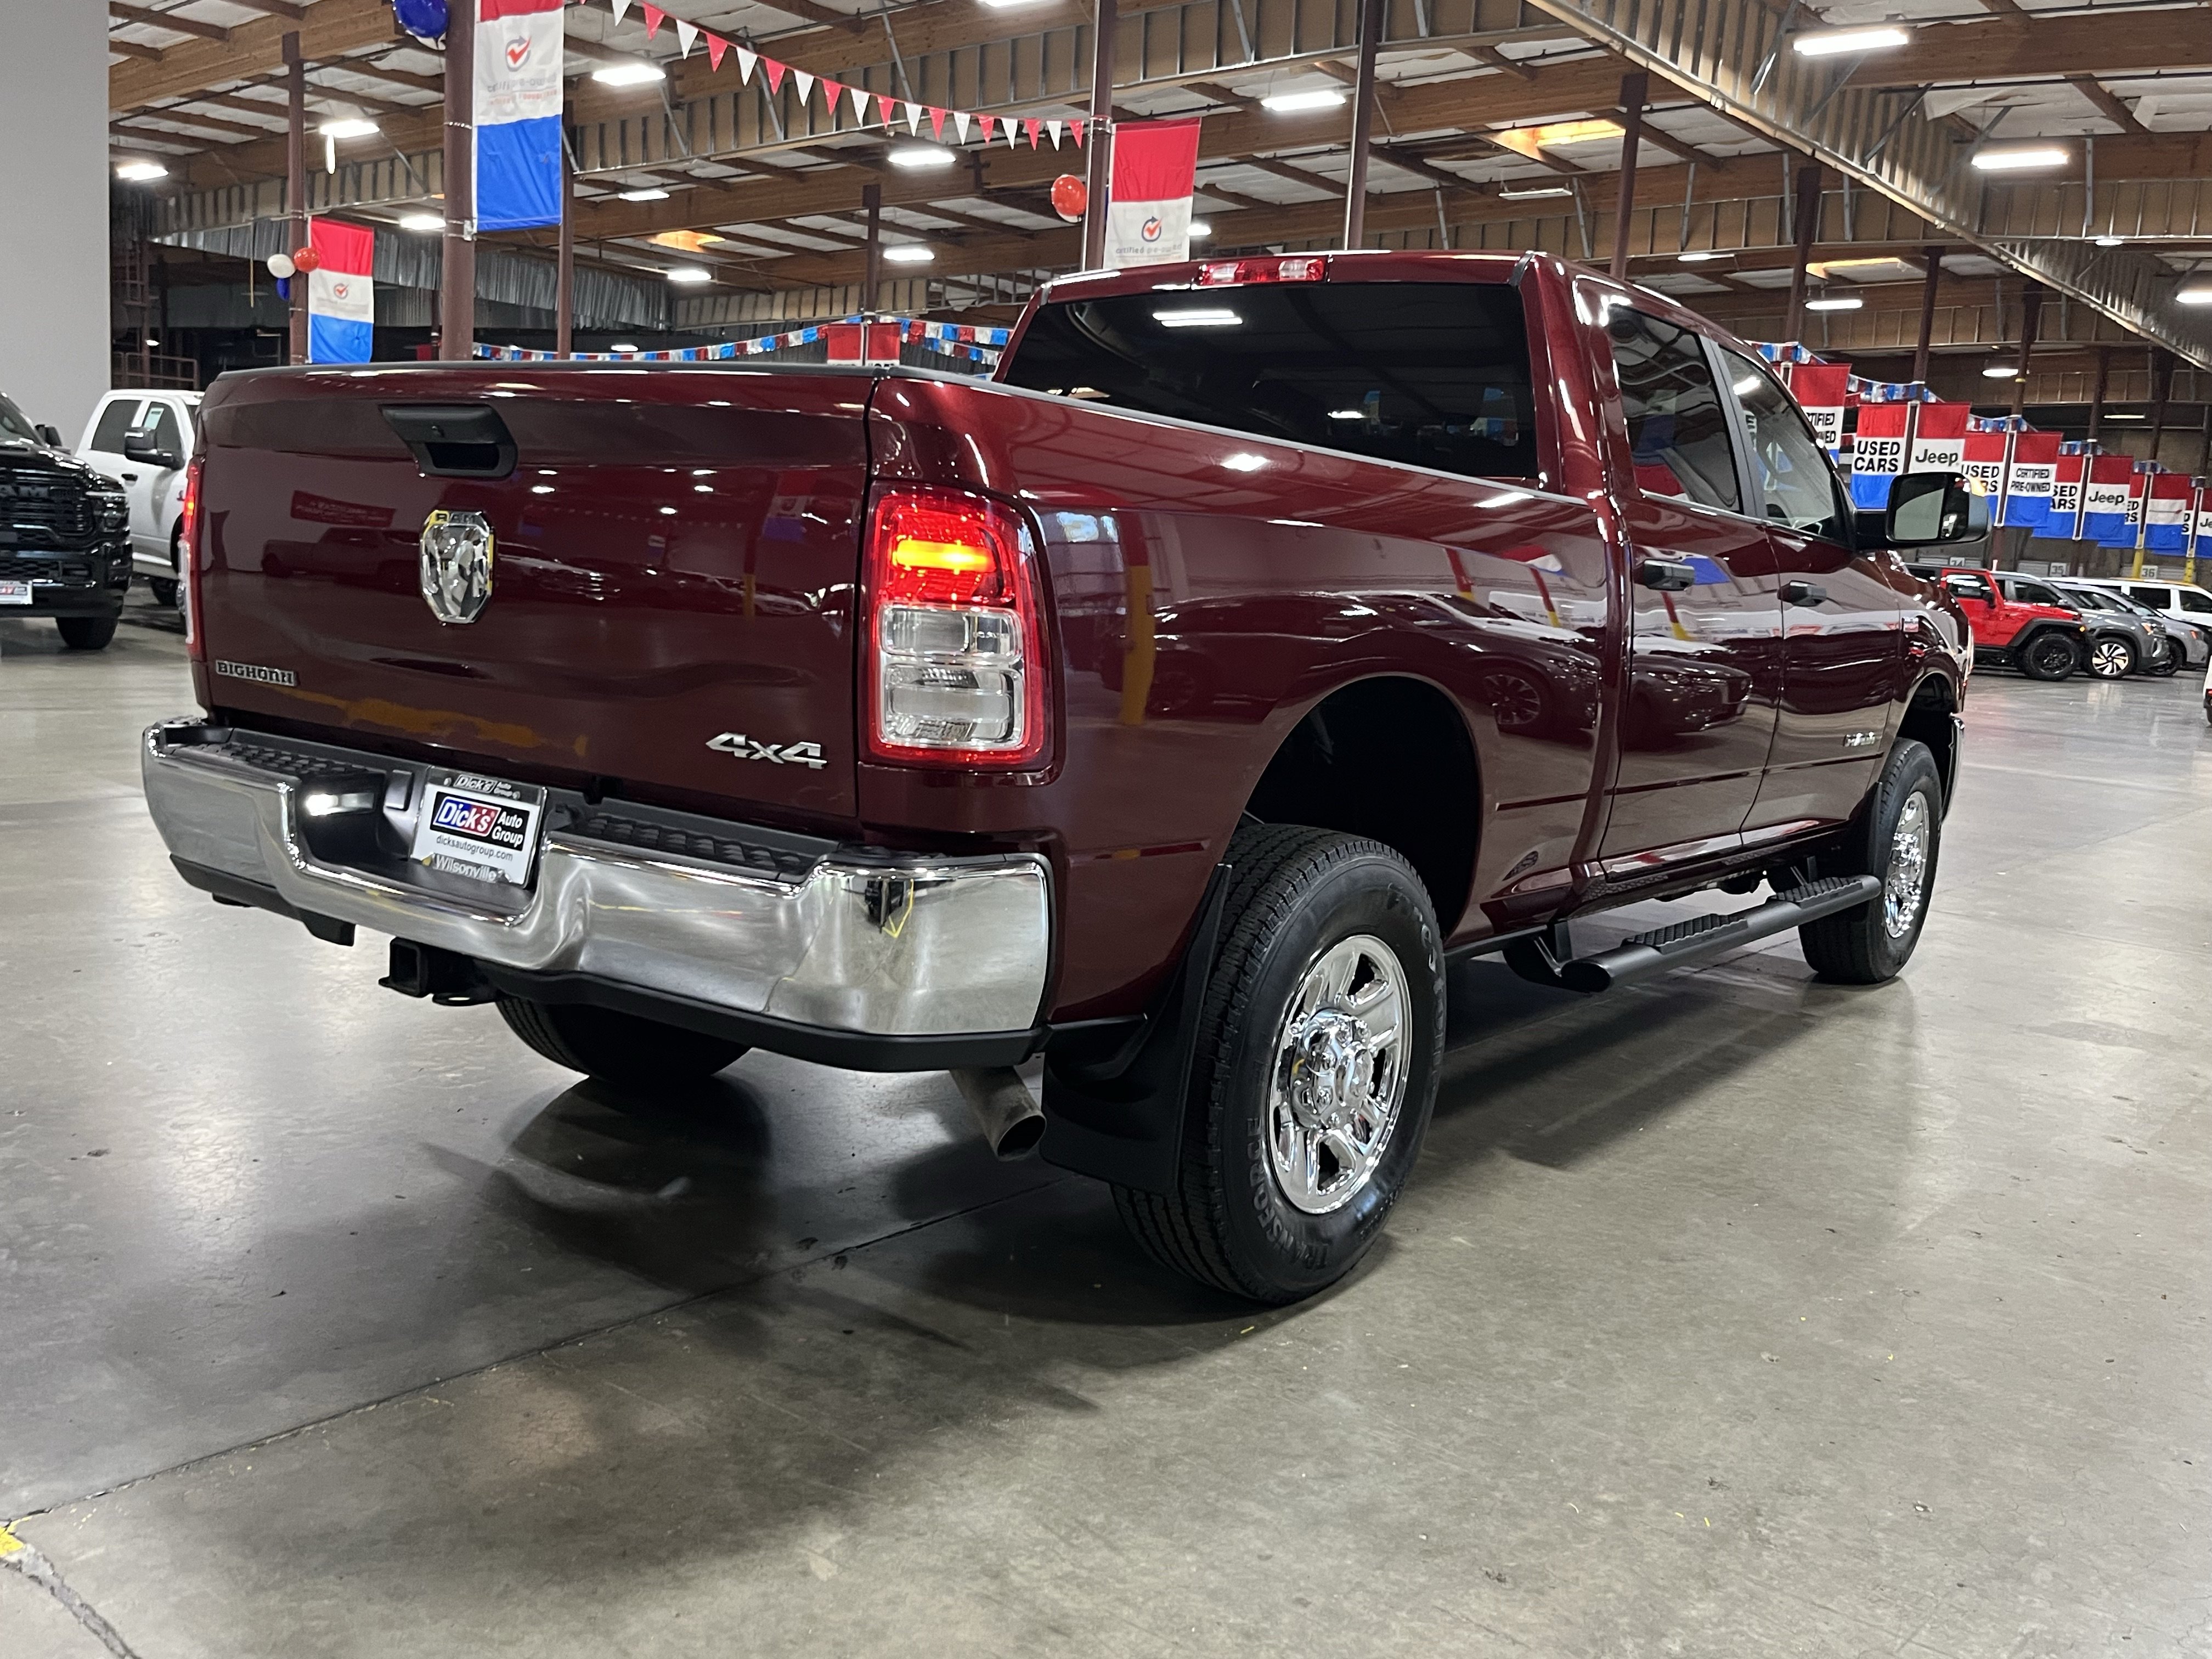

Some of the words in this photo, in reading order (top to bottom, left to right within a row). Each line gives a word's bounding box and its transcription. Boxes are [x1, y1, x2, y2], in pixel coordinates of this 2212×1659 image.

[1806, 413, 1835, 426] TIFIED
[1857, 441, 1900, 456] USED
[1854, 457, 1898, 472] CARS
[1915, 449, 1958, 466] Jeep
[1961, 465, 1999, 478] USED
[2016, 467, 2050, 479] CERTIFIED
[2010, 481, 2051, 493] PRE-OWNED
[2052, 485, 2078, 496] SED
[2051, 498, 2076, 510] ARS
[2089, 491, 2125, 505] Jeep
[2051, 566, 2063, 574] 35
[2141, 568, 2155, 578] 36
[217, 662, 293, 684] BIGHORN
[438, 802, 492, 832] Dick's
[496, 811, 523, 828] Auto
[492, 827, 523, 848] Group
[436, 834, 514, 862] dicksautogroup.com
[434, 854, 498, 883] Wilsonville
